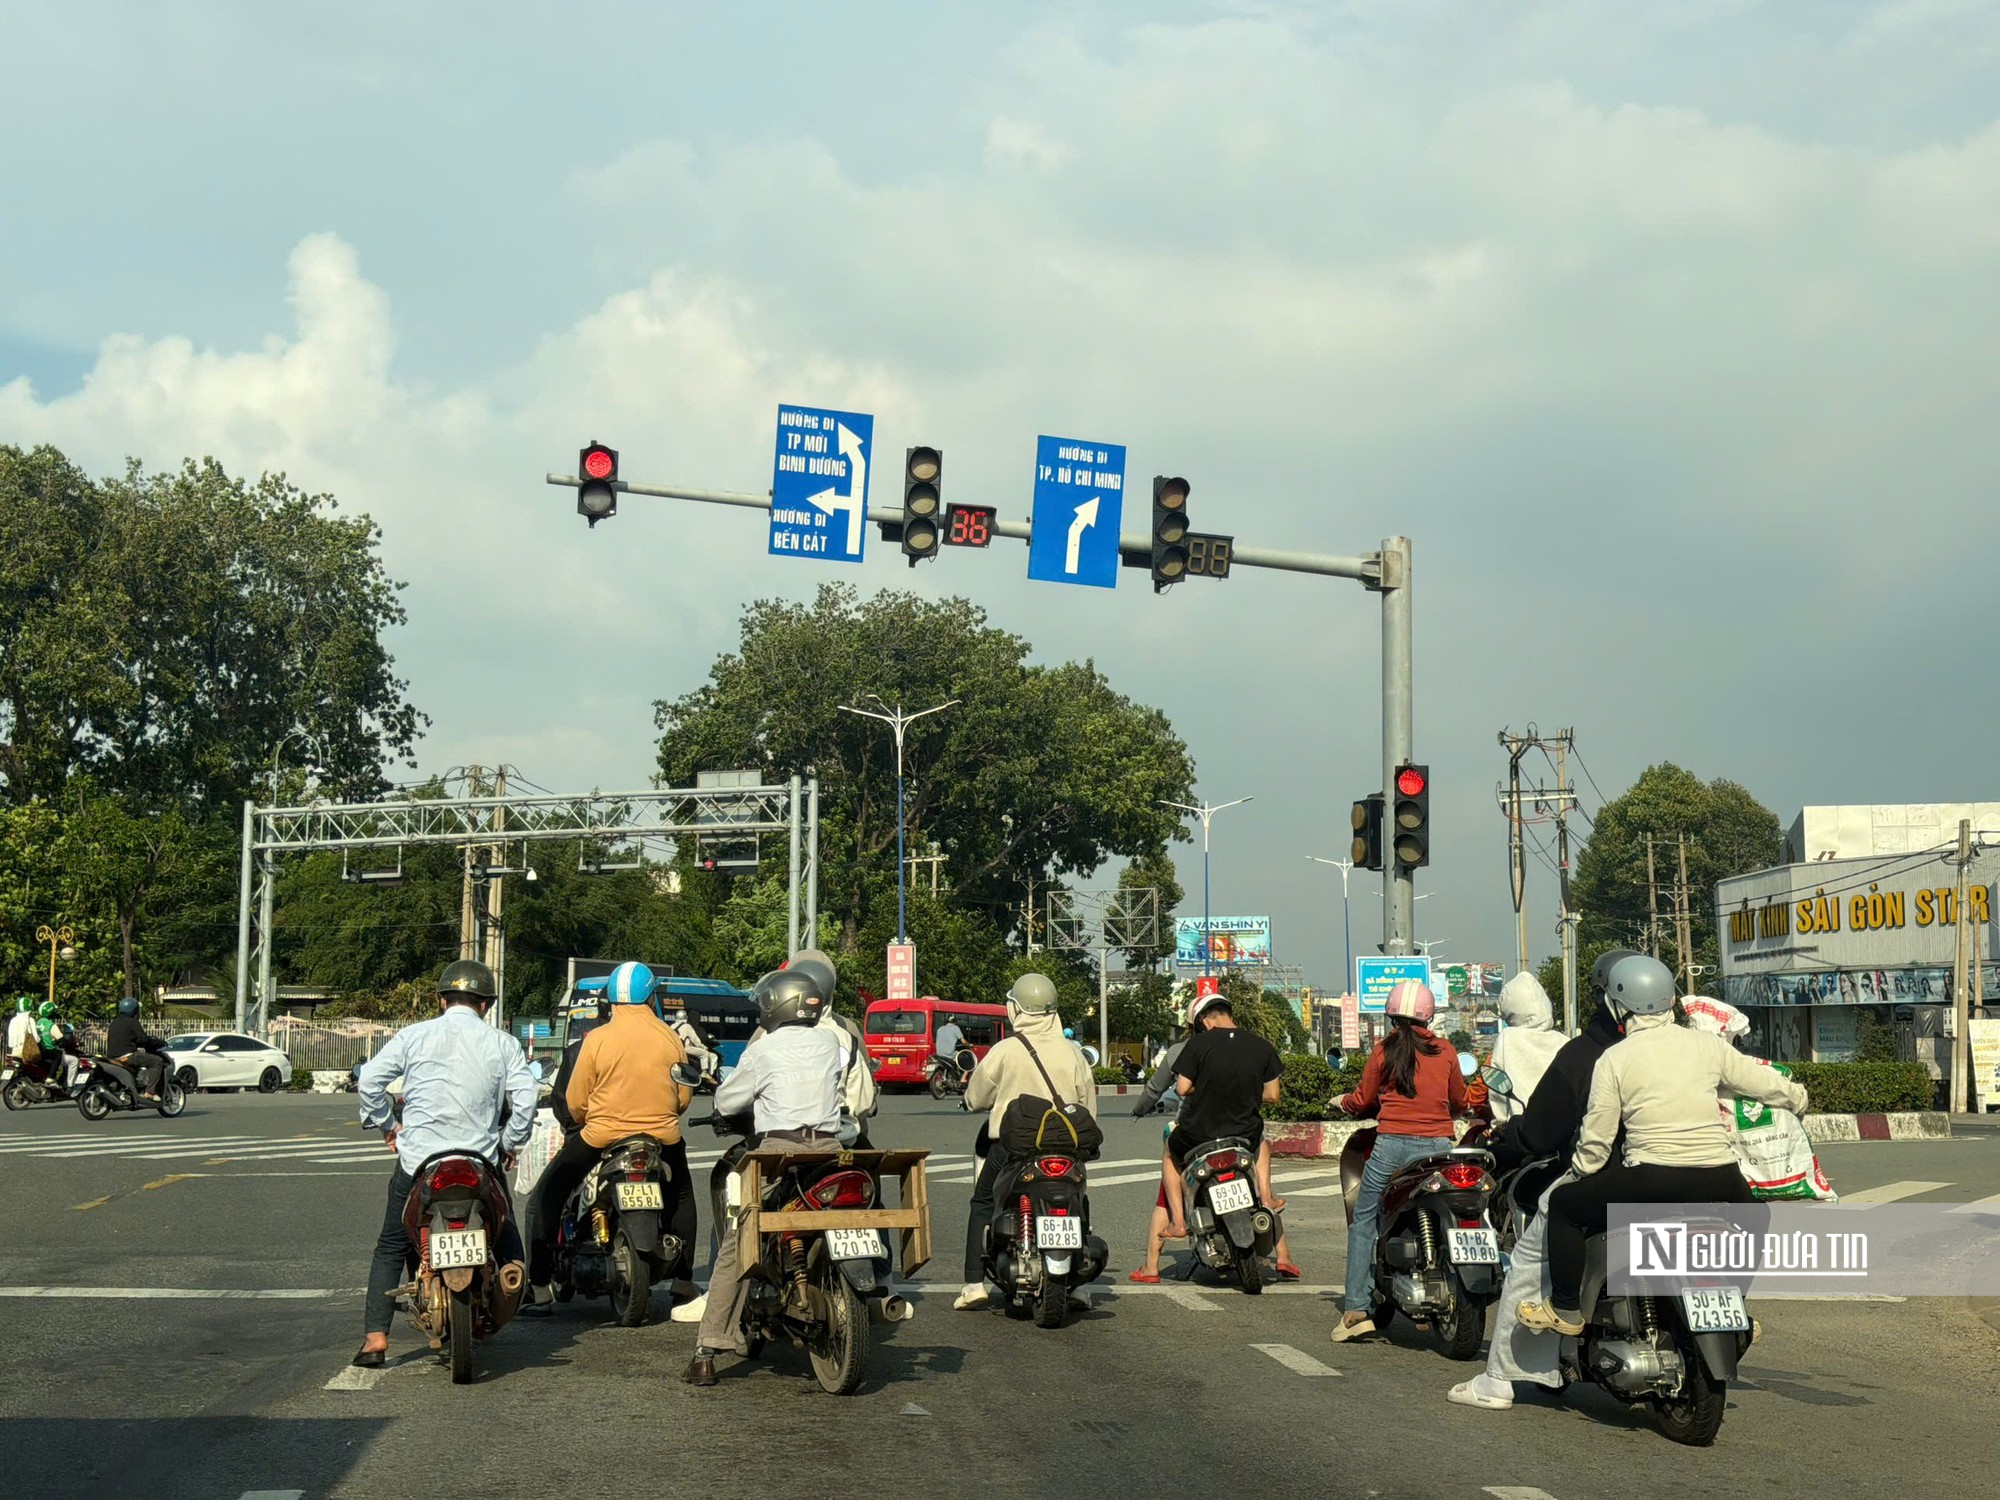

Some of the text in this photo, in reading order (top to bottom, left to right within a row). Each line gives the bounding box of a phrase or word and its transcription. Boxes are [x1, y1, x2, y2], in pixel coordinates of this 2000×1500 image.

[780, 410, 835, 431] HƯỚNG ĐI
[787, 432, 828, 453] TP MỚI
[1058, 444, 1094, 463] HƯỚNG
[779, 452, 846, 477] BÌNH DƯƠNG
[1039, 465, 1055, 482] TP.
[1057, 463, 1072, 484] HỒ
[1094, 471, 1122, 490] MINH
[773, 506, 827, 527] HƯỚNG ĐI
[952, 509, 988, 544] 36
[773, 527, 800, 550] BẾN
[1796, 887, 1840, 934] SÀI
[1850, 882, 1905, 929] GÒN
[623, 1184, 655, 1196] 67-L1
[621, 1196, 661, 1209] 655.84
[1215, 1193, 1251, 1211] 320.45
[1043, 1218, 1075, 1232] 66-AA
[439, 1232, 477, 1249] 61-K1
[1040, 1232, 1079, 1247] 082.85
[1455, 1232, 1489, 1246] 61-B2
[434, 1247, 484, 1266] 315.85
[834, 1240, 880, 1258] 420.18
[1453, 1246, 1496, 1261] 330.80
[1691, 1291, 1734, 1308] 50-AF
[1691, 1309, 1744, 1330] 243.56
